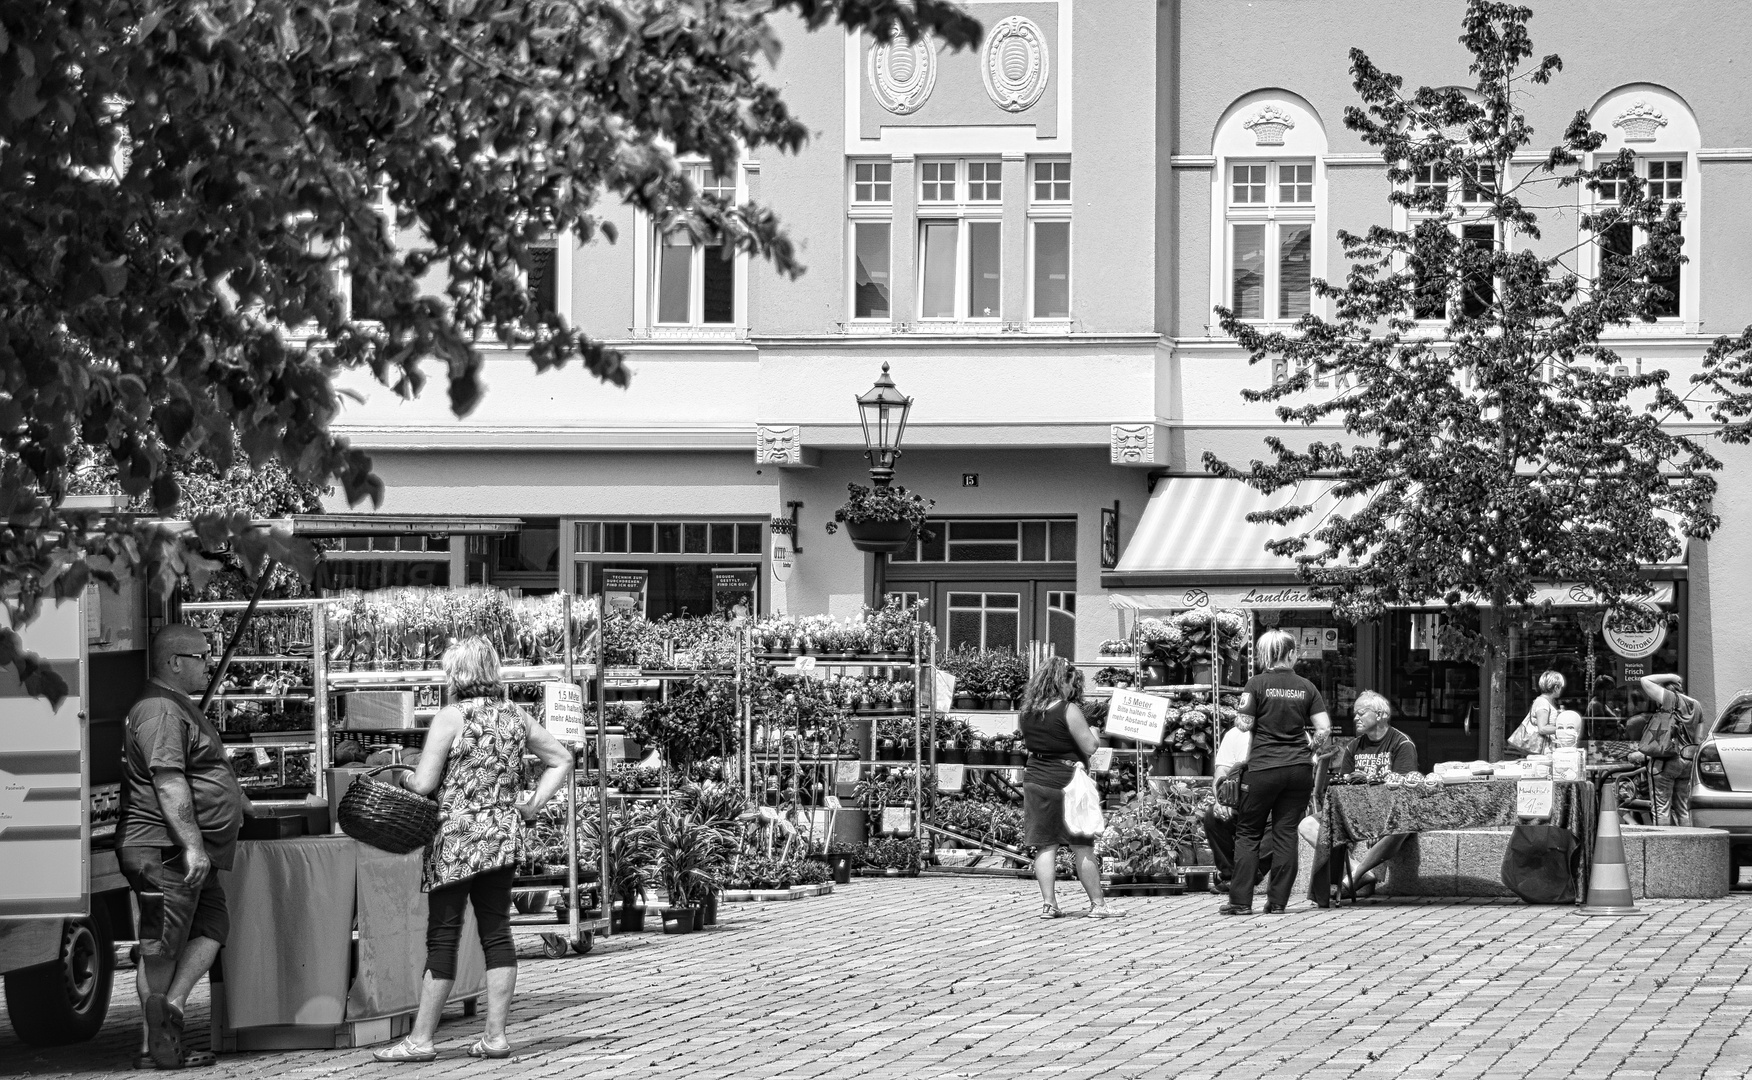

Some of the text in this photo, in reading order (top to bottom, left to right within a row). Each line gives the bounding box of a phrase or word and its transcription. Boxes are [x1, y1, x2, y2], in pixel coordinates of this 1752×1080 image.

[966, 476, 974, 485] 15
[1616, 636, 1653, 650] KONDITOREI
[1133, 698, 1152, 708] Meter
[1117, 705, 1157, 719] Bitte halten Sie
[1125, 716, 1148, 726] Abstand
[1148, 721, 1158, 729] als
